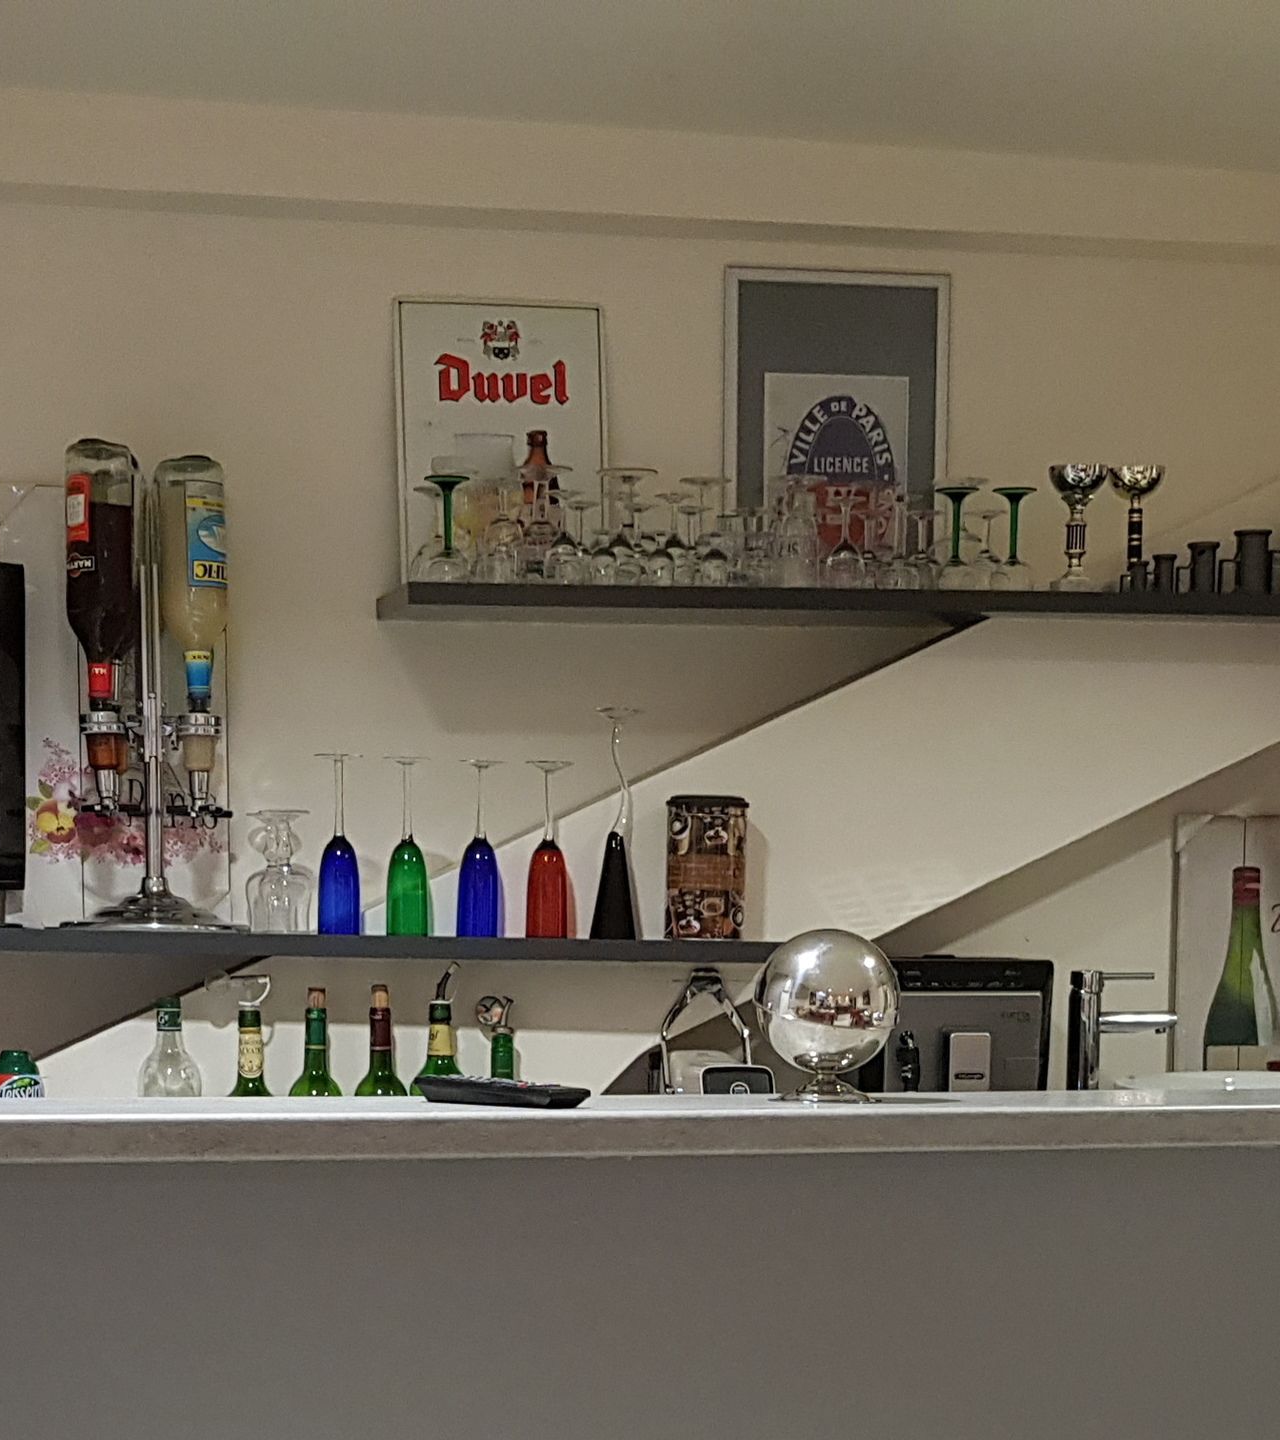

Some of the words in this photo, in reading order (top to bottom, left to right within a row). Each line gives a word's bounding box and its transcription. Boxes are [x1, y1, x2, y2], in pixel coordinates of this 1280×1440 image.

[434, 353, 570, 406] Duvel
[790, 405, 828, 465] VILLE
[831, 401, 847, 412] DE
[851, 403, 891, 466] PARIS
[814, 456, 870, 473] LICENCE
